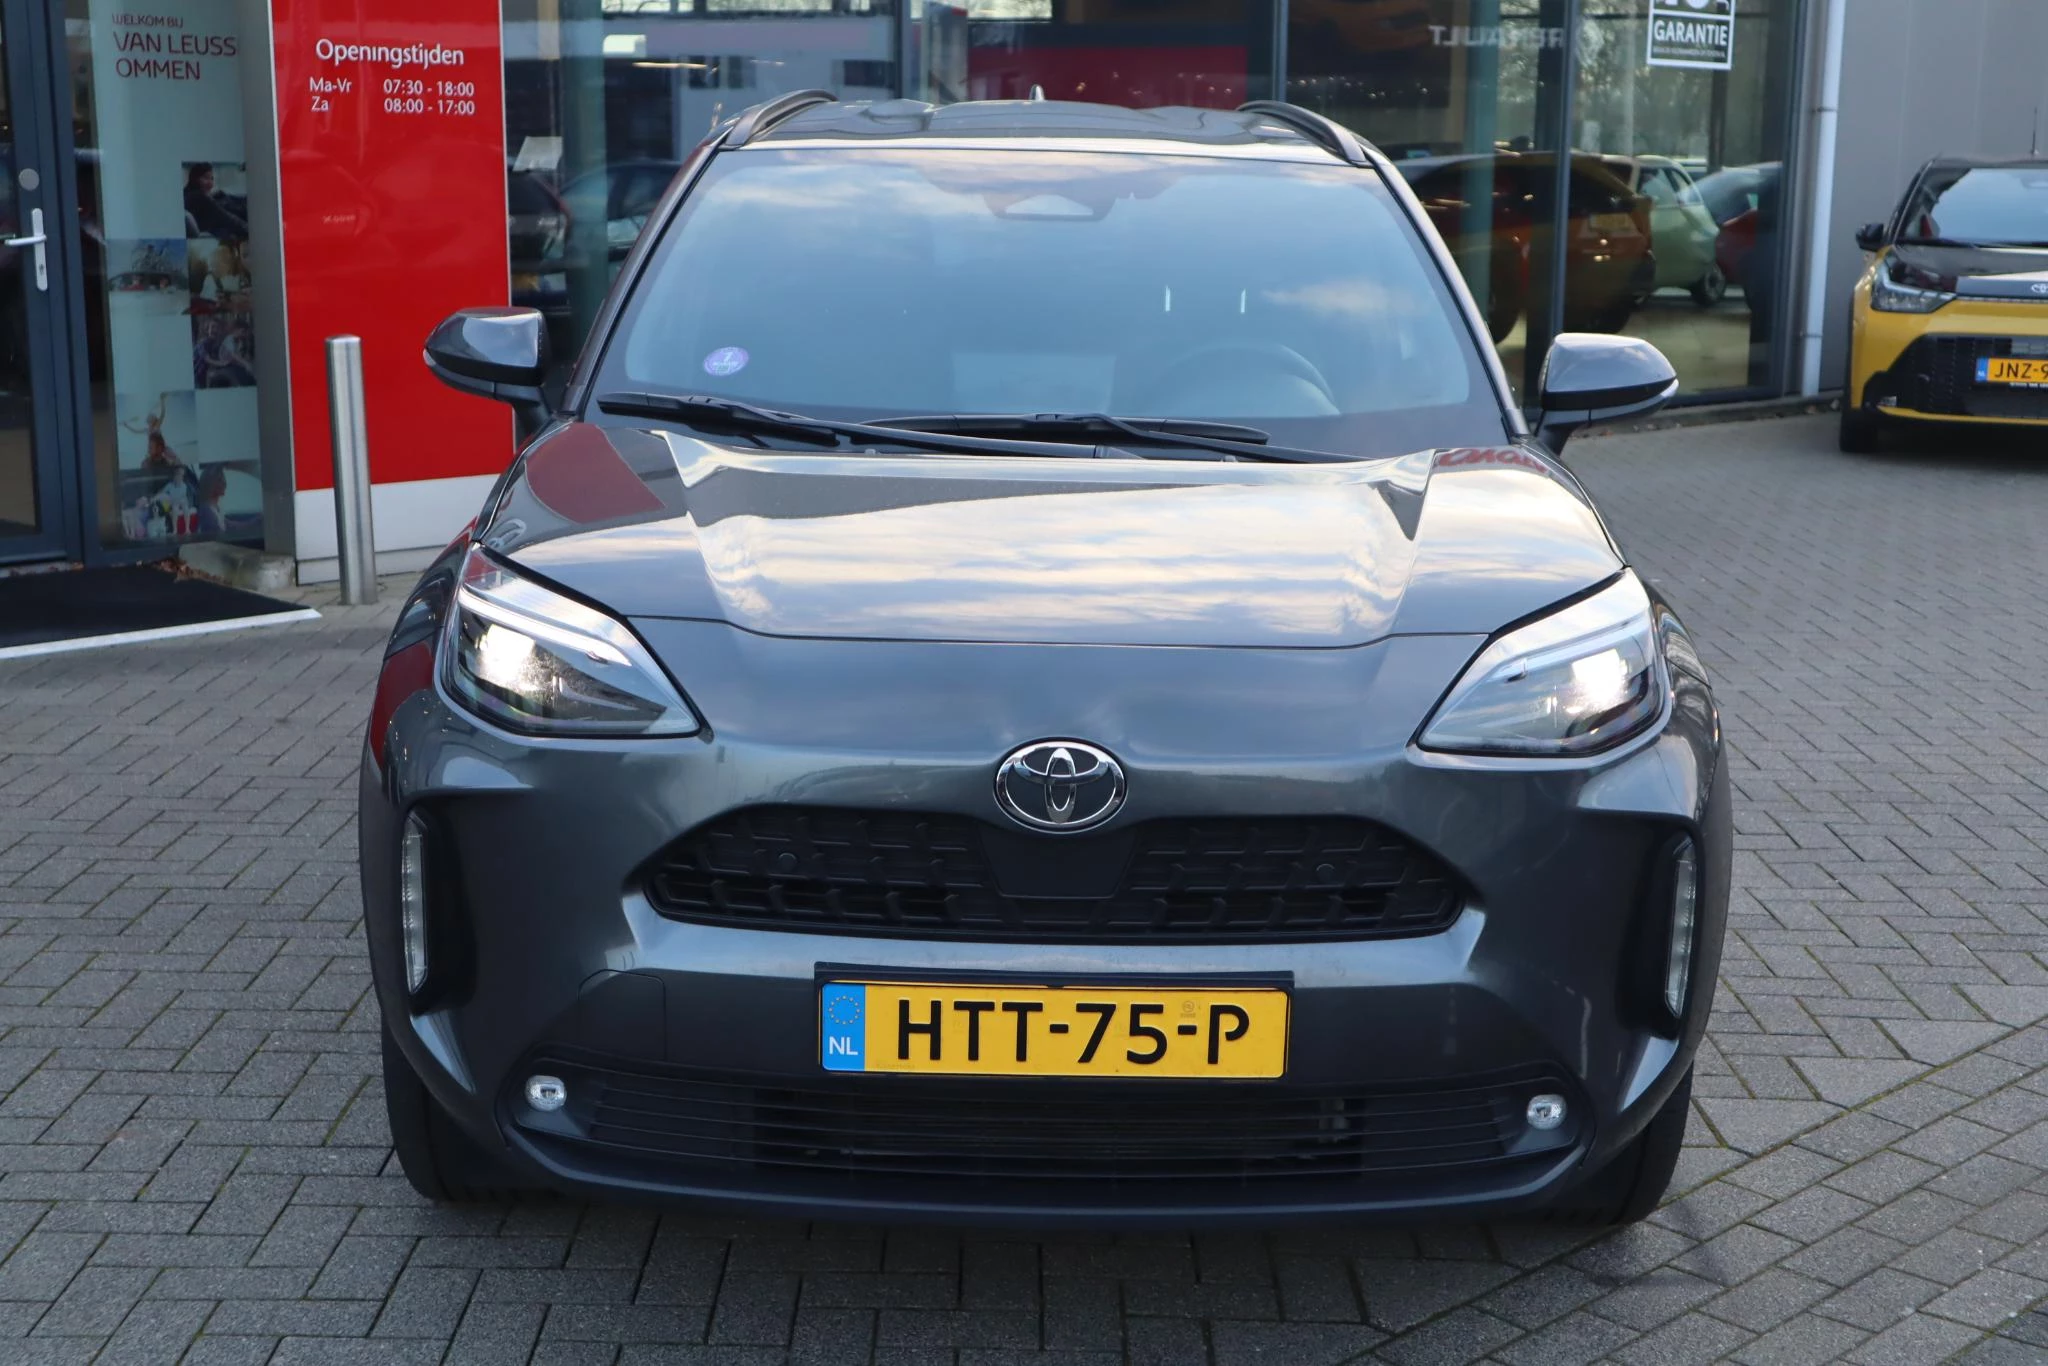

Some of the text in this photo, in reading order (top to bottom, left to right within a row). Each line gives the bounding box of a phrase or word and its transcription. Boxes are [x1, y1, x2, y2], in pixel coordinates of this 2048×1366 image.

[111, 13, 184, 28] WELKOM BIJ
[1654, 19, 1728, 47] GARANTIE
[113, 31, 237, 57] VAN LEUSS
[316, 38, 465, 70] Openingstijden
[116, 58, 200, 80] OMMEN
[309, 76, 352, 93] Ma-Vr
[383, 79, 423, 96] 07:30
[437, 81, 475, 97] 18:00
[311, 96, 329, 112] Za
[383, 98, 424, 113] 08:00
[438, 100, 476, 116] 17:00
[1994, 361, 2048, 380] JNZ-9
[898, 998, 1250, 1065] HTT-75-P
[829, 1036, 858, 1056] NL
